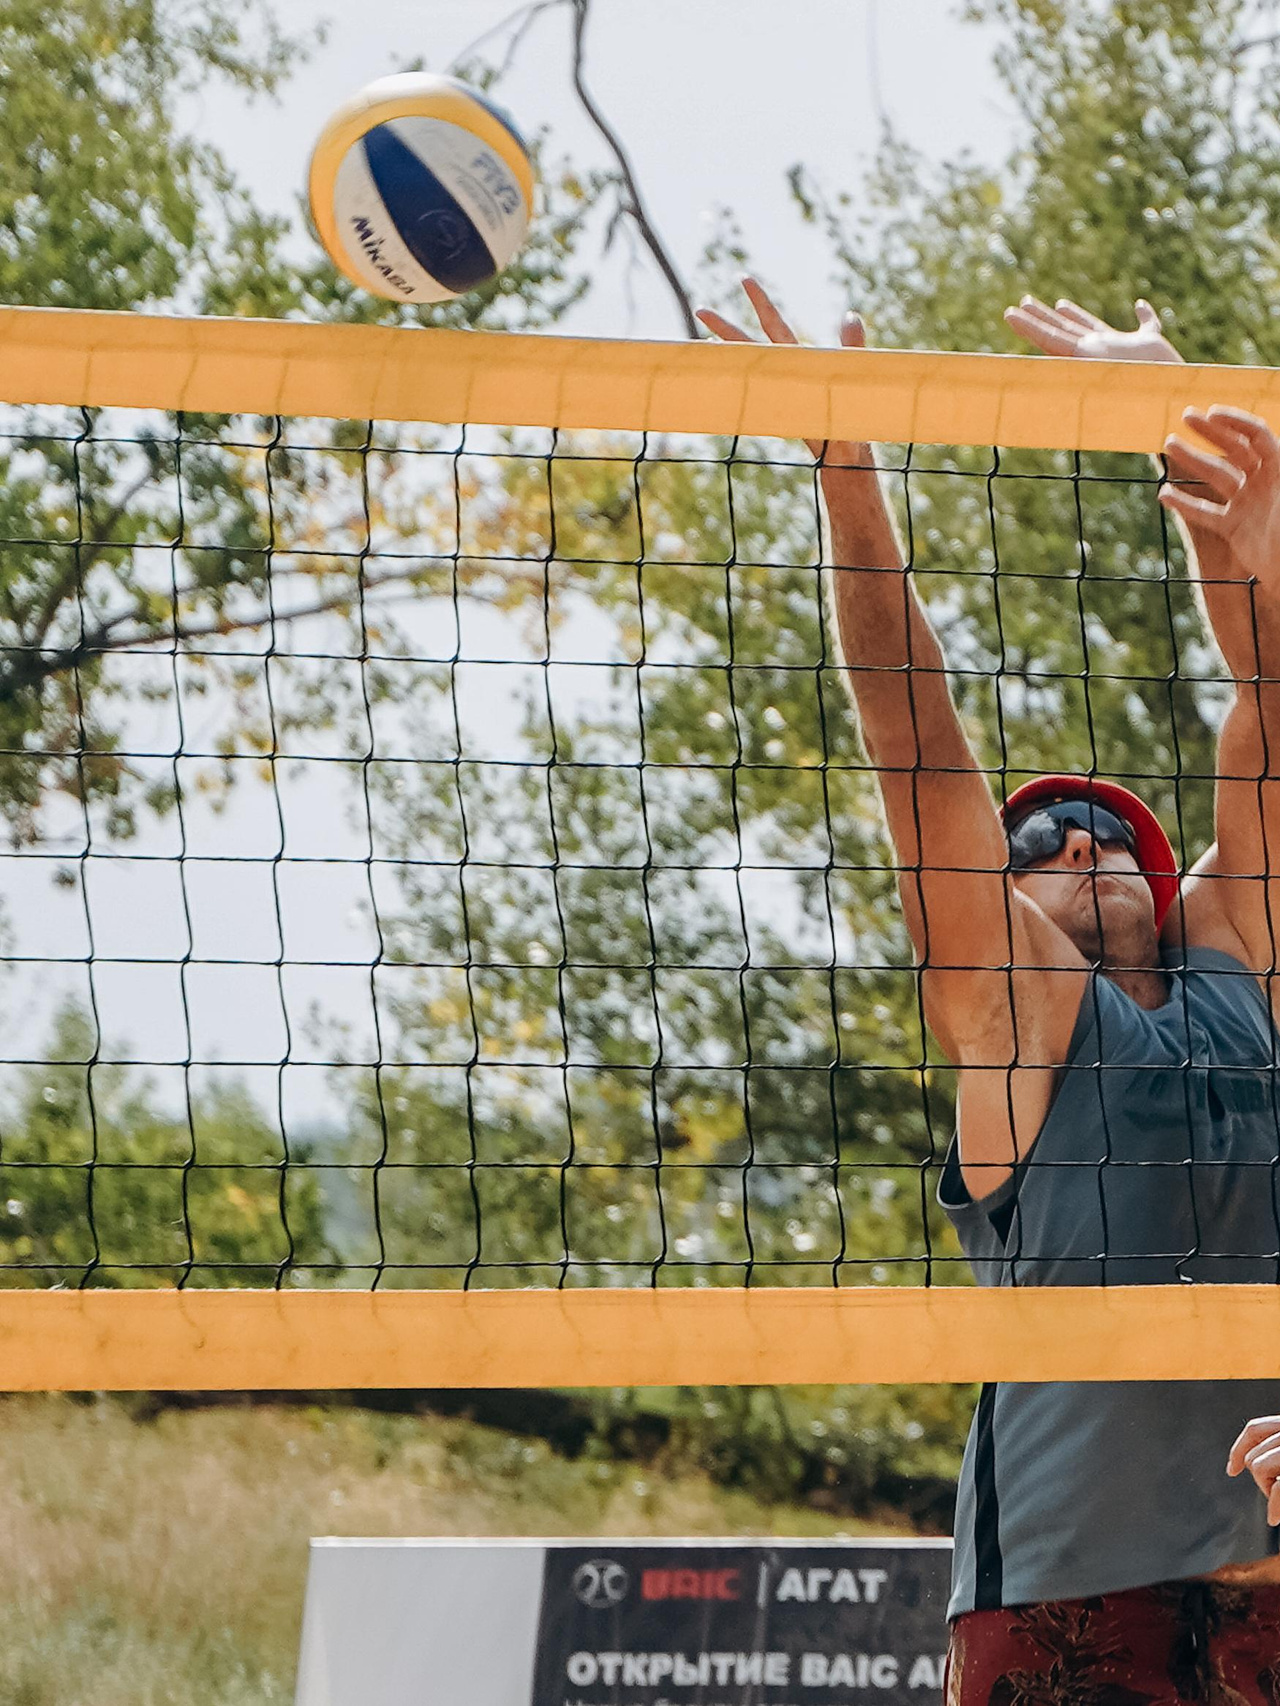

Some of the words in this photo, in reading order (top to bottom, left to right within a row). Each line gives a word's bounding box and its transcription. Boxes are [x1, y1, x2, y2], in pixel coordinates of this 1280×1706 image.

[775, 1567, 888, 1602] АГАТ
[566, 1651, 791, 1687] ОТКРЫТИЕ
[801, 1651, 898, 1689] BAIC
